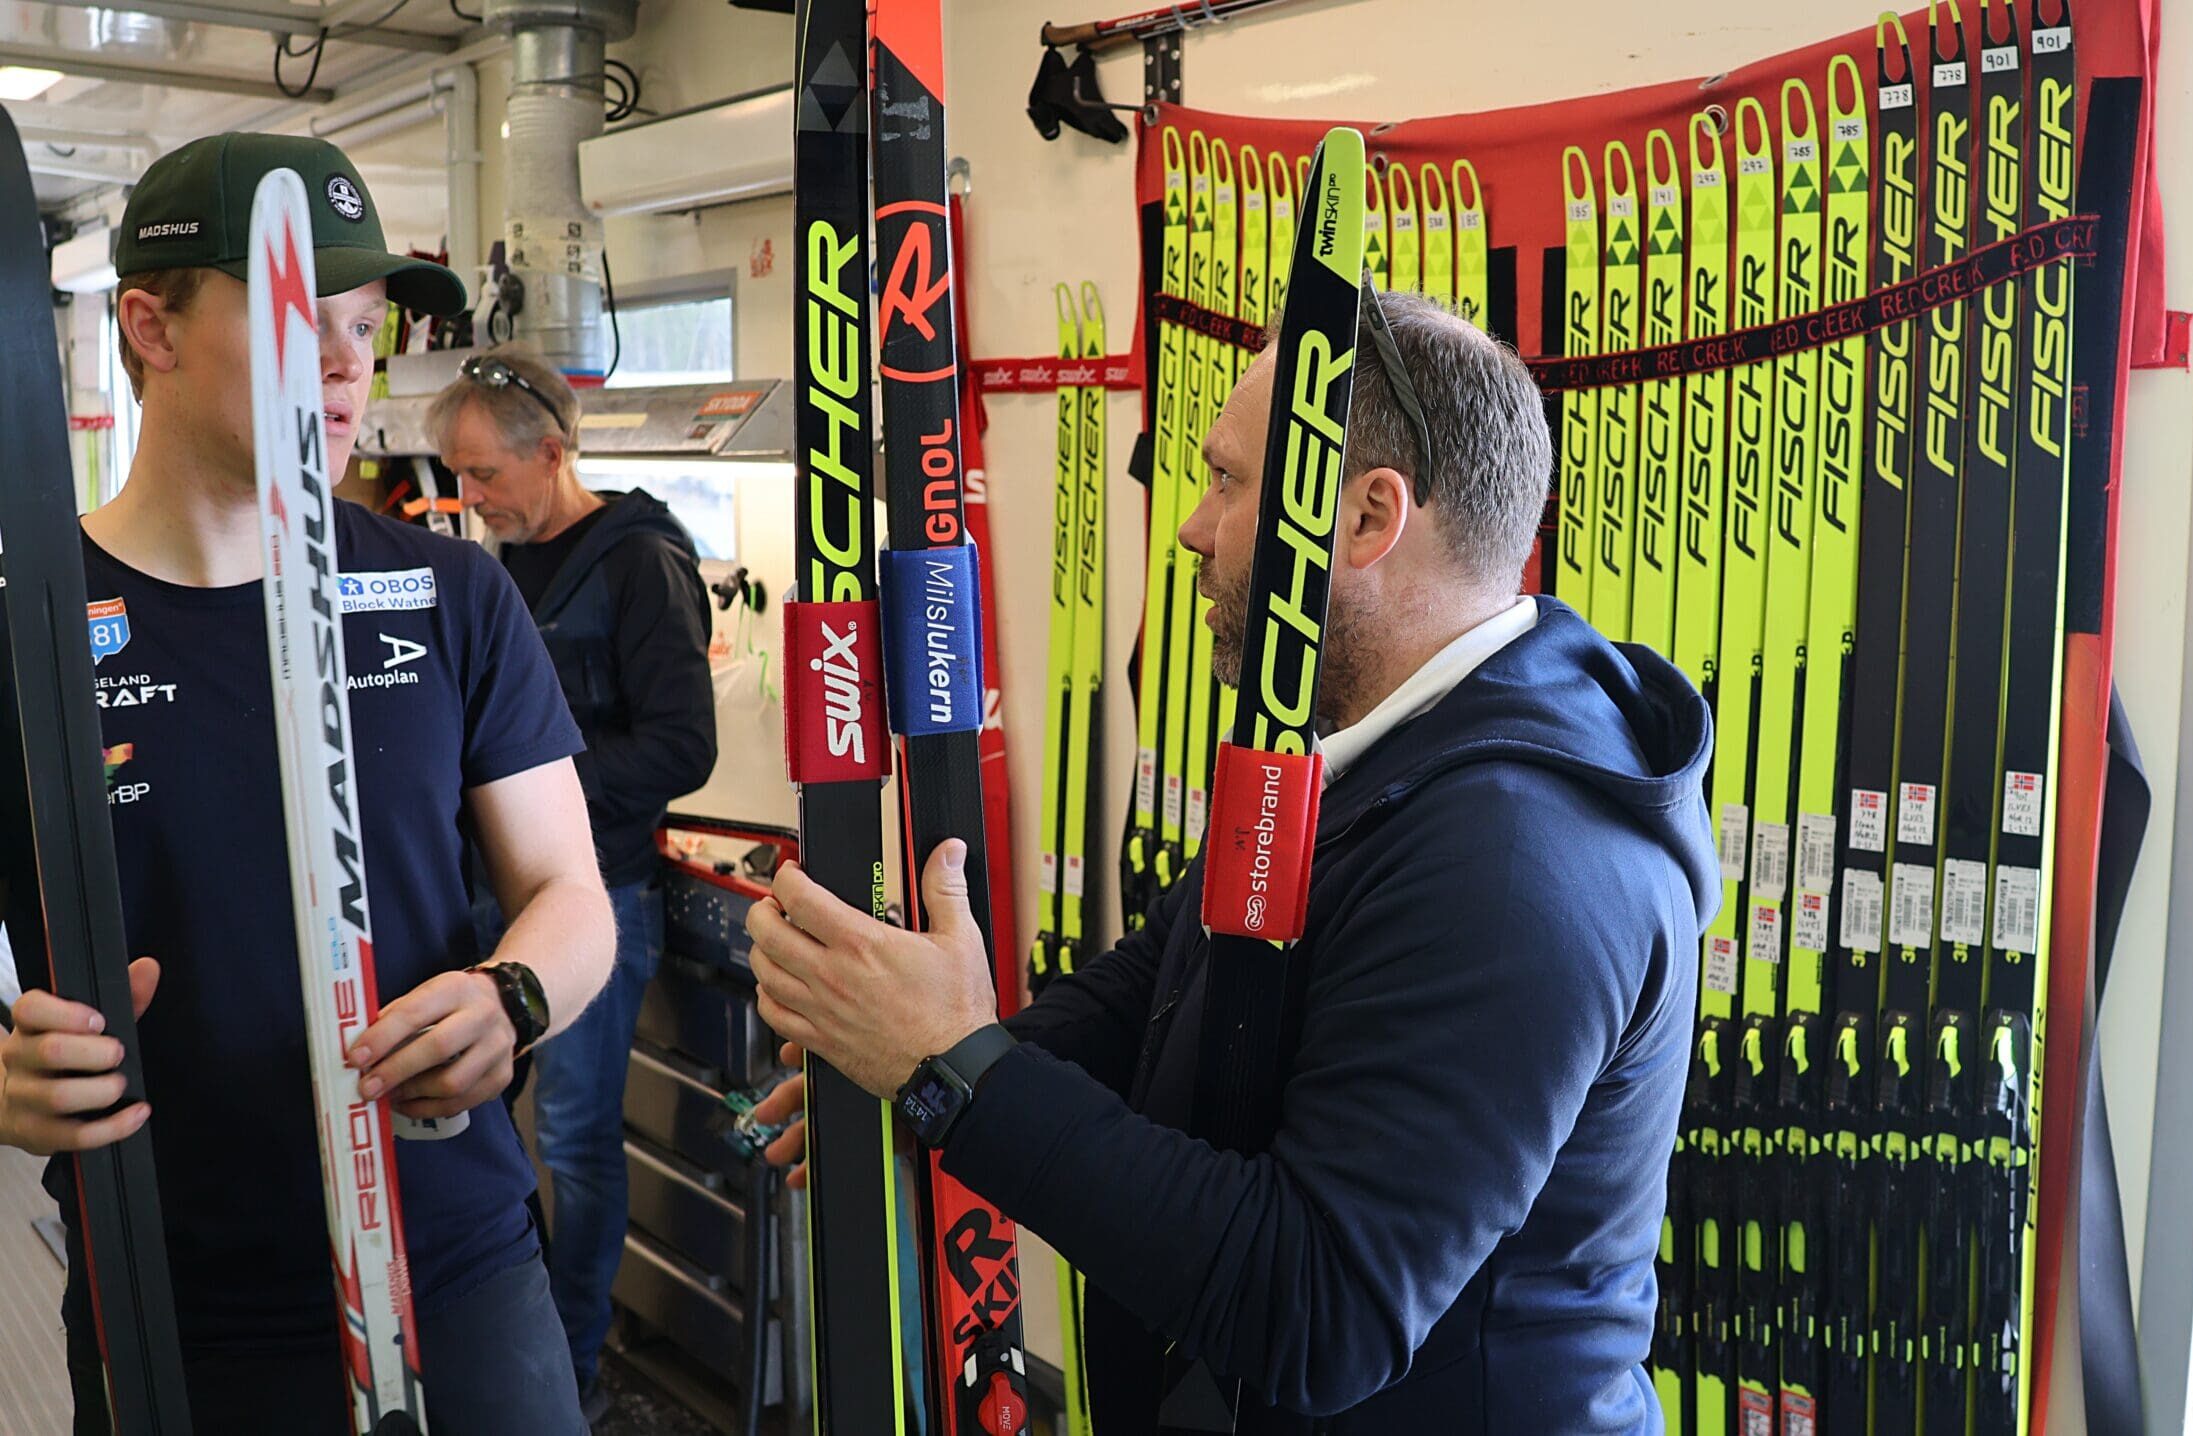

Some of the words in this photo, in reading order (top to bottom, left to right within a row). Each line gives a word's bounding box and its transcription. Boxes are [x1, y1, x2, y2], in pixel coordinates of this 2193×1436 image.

[138, 222, 200, 240] MADSHUS
[808, 220, 862, 603] CHER
[920, 418, 958, 549] GNOL
[1054, 393, 1072, 608] FISCHER
[1080, 390, 1099, 608] FISCHER
[1254, 329, 1354, 754] CHER
[342, 598, 386, 612] Block
[388, 596, 437, 608] Watne
[370, 575, 434, 594] OBOS
[926, 560, 956, 724] Milslukern
[297, 407, 368, 932] MADSHUS
[346, 669, 419, 690] Autoplan
[1249, 765, 1282, 892] storebrand
[333, 977, 382, 1231] REDLNE
